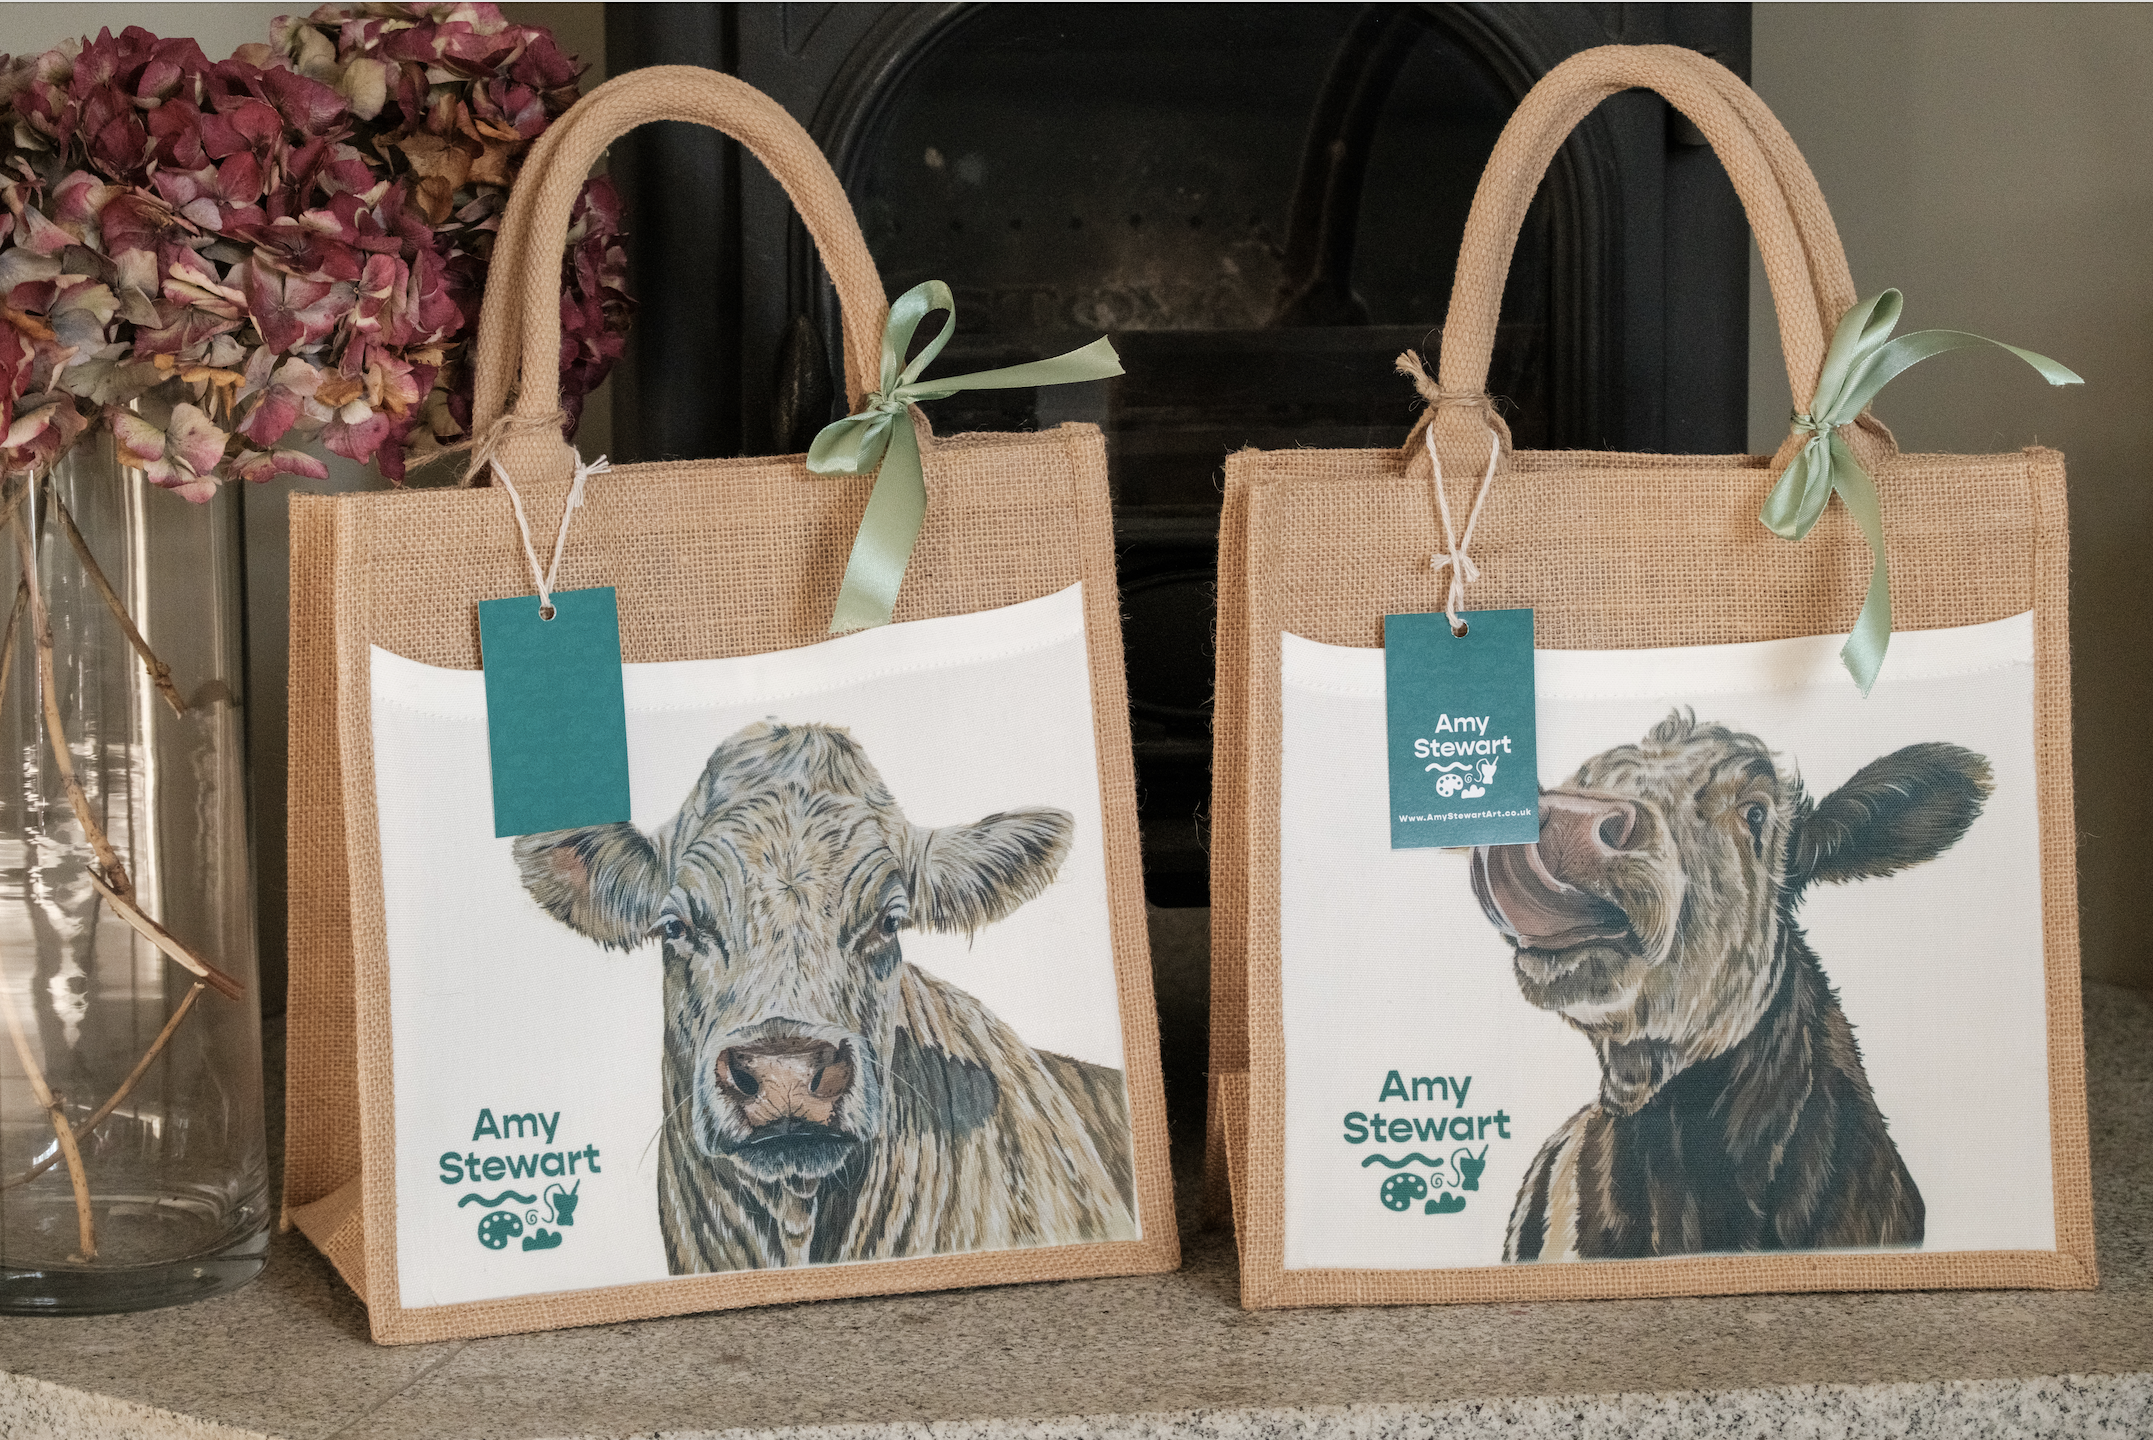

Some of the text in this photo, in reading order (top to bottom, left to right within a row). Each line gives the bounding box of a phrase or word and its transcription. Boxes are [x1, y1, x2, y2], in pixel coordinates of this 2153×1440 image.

[1434, 713, 1490, 736] Amy
[1413, 735, 1512, 759] Stewart
[1379, 1069, 1472, 1109] Amy
[472, 1107, 561, 1145] Amy
[1343, 1109, 1511, 1145] Stewart
[439, 1143, 602, 1185] Stewart
